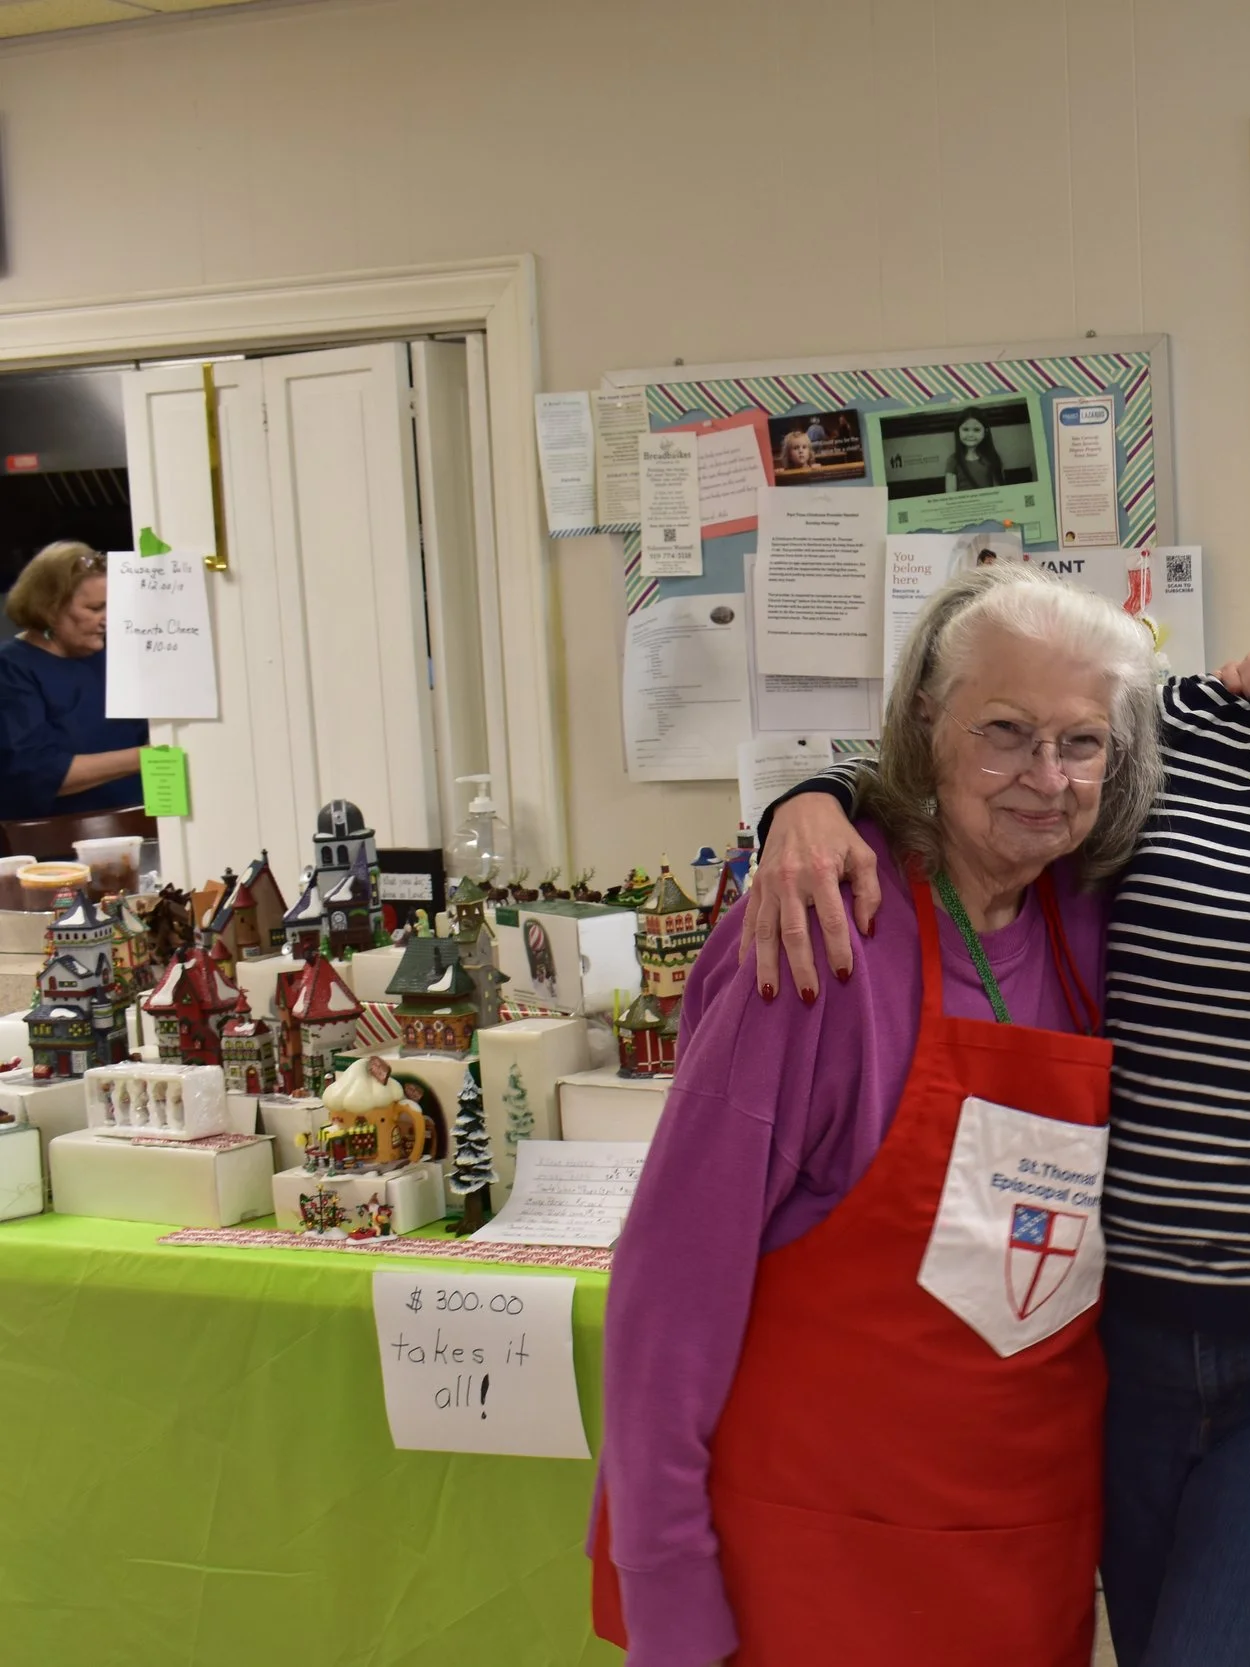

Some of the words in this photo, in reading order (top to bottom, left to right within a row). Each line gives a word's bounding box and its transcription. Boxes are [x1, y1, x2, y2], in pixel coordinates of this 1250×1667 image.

[893, 551, 915, 562] You
[120, 561, 166, 580] Sausage
[892, 562, 933, 576] belong
[1041, 560, 1086, 574] ANT
[892, 574, 919, 585] here
[990, 1172, 1071, 1203] Episcopal
[405, 1286, 423, 1314] $
[435, 1289, 524, 1316] 300.00
[391, 1328, 485, 1365] takes
[506, 1332, 531, 1367] it
[434, 1372, 490, 1421] all!
